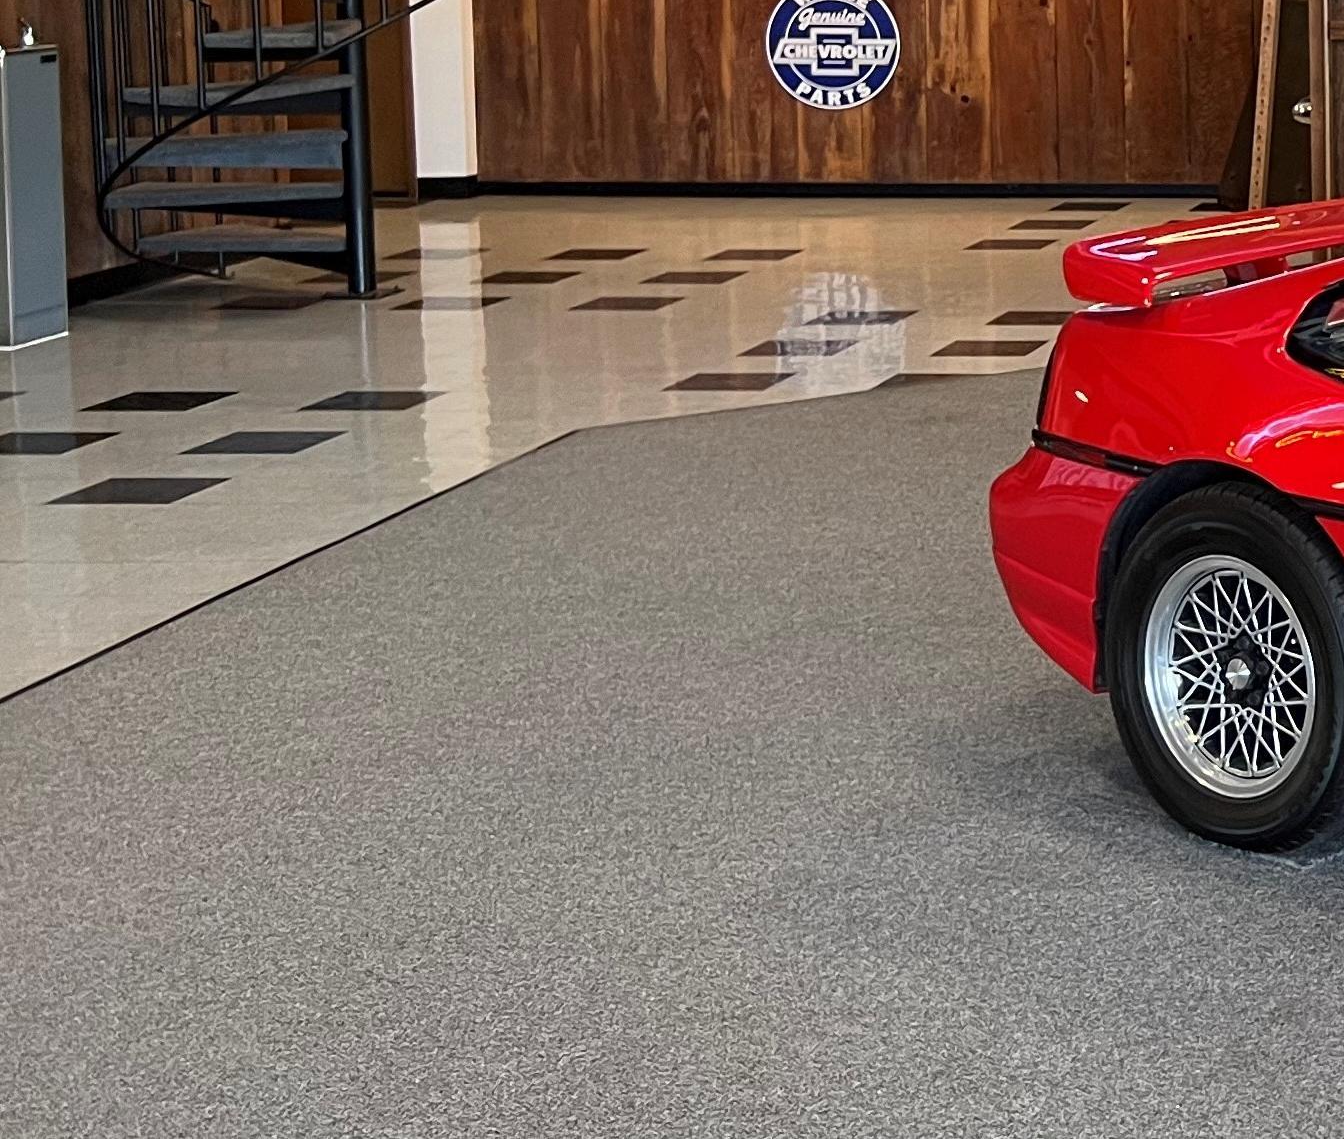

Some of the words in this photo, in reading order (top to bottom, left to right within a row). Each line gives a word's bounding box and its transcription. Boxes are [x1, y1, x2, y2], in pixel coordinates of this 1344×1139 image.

[798, 7, 866, 31] Genuine
[784, 45, 886, 60] CHEVROLET
[795, 81, 872, 106] PARTS
